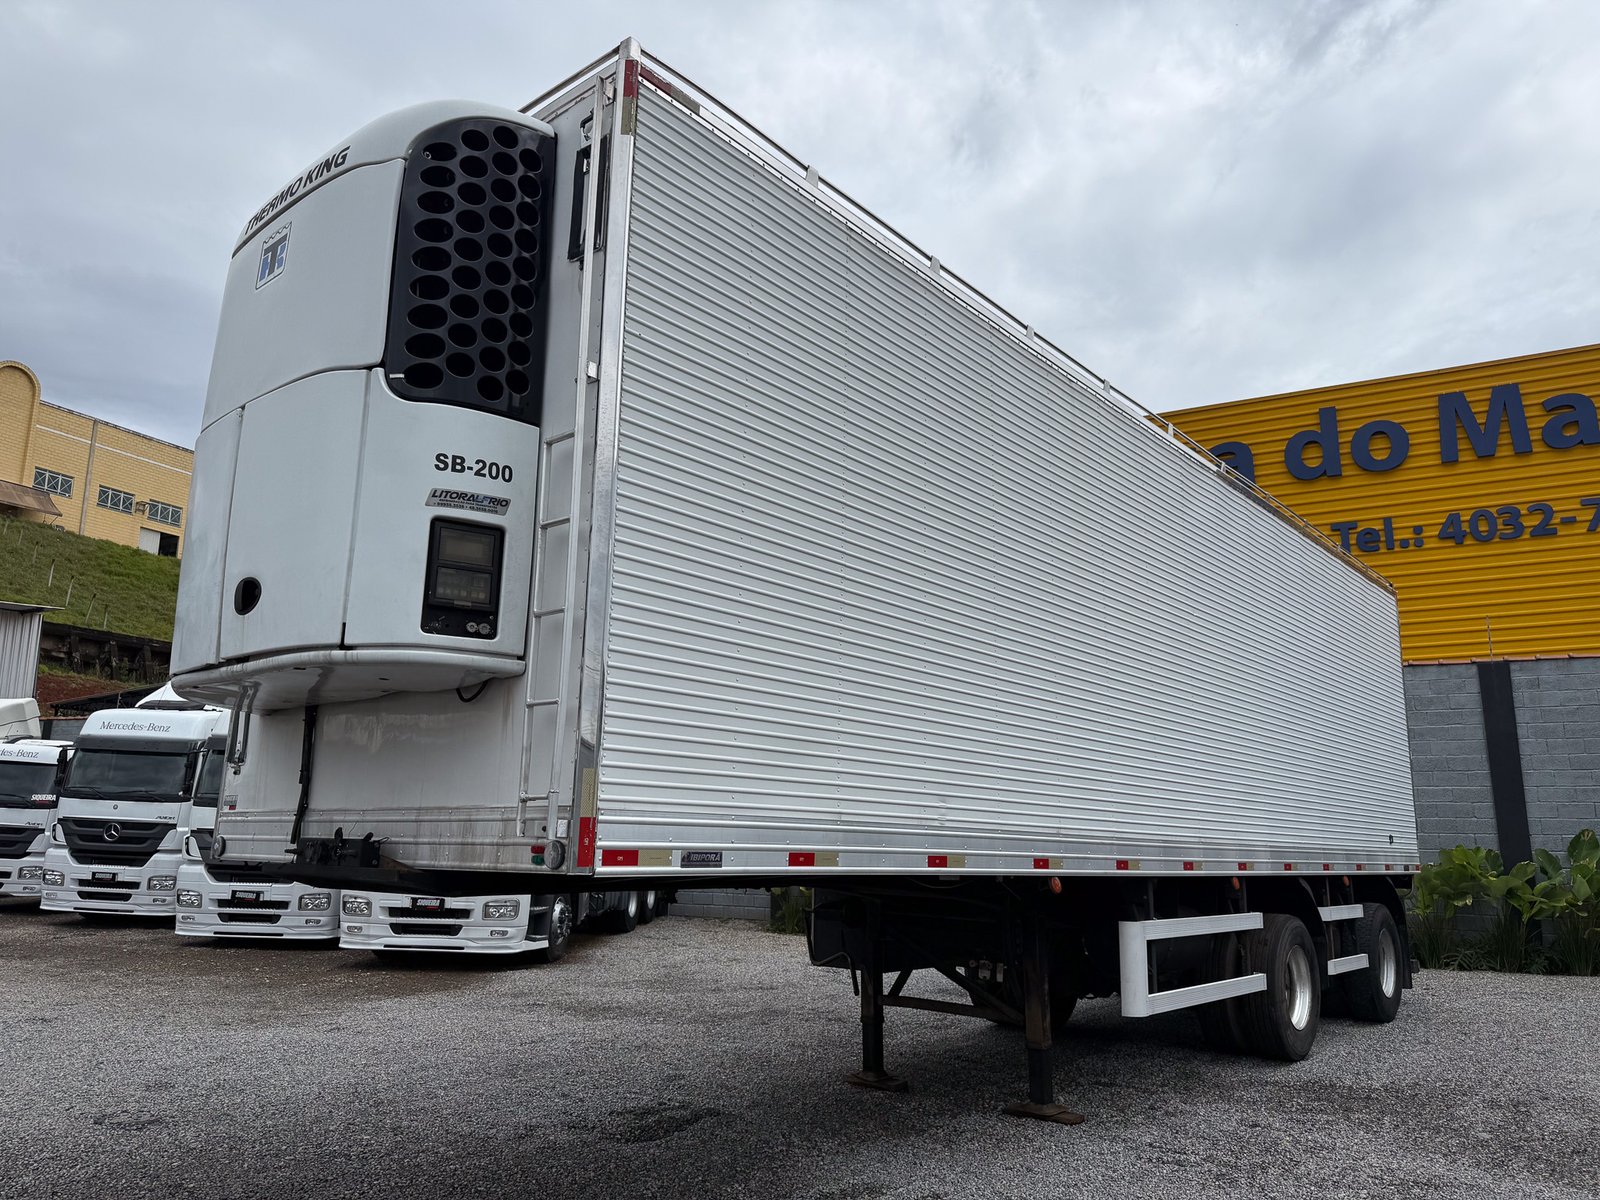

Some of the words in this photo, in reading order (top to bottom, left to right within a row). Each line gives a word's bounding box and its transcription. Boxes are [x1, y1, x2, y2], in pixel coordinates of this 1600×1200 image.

[245, 176, 303, 235] THERMO
[303, 145, 351, 188] KING
[1284, 406, 1410, 480] do
[1438, 383, 1600, 463] Ma
[433, 452, 513, 483] SB-200
[1330, 517, 1424, 553] Tel.:
[99, 720, 171, 733] Mercedes-Benz
